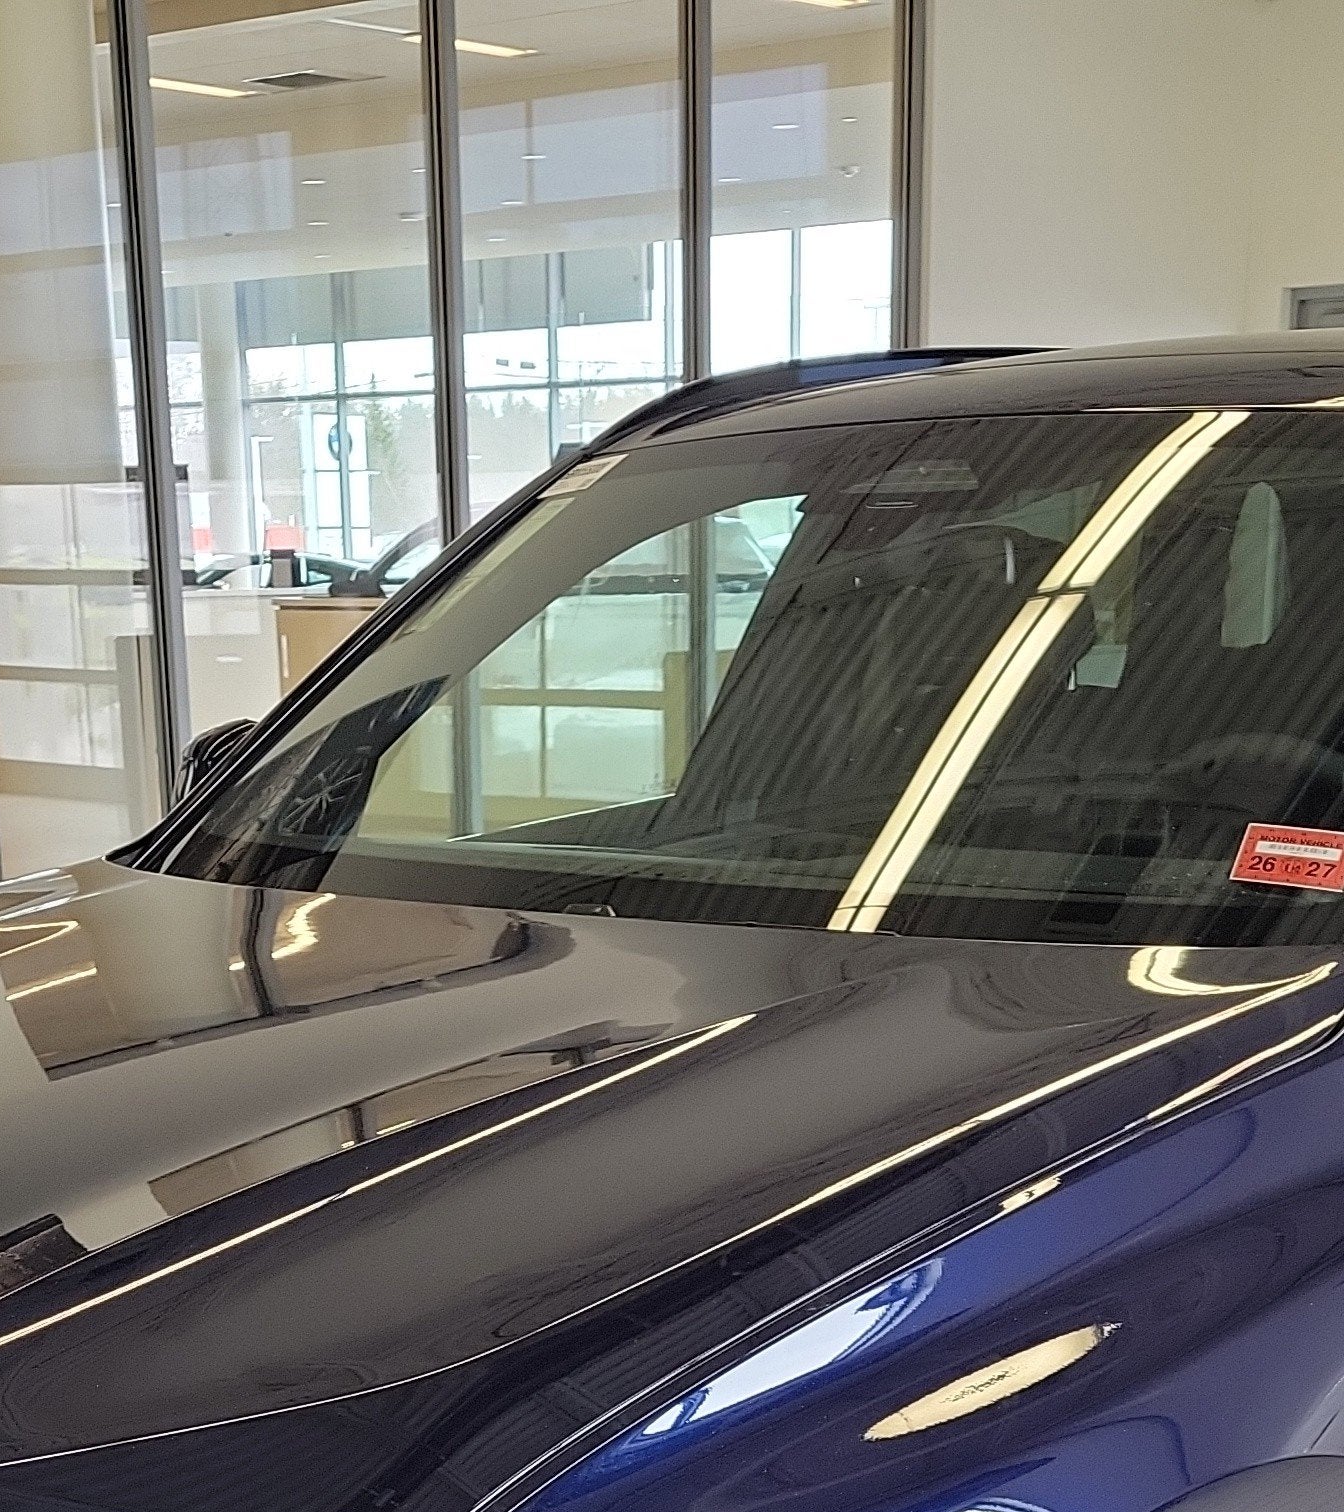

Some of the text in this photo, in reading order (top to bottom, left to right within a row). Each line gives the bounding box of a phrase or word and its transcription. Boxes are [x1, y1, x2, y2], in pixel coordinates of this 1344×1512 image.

[1260, 835, 1344, 849] MOTOR VEHICLE
[1247, 855, 1277, 872] 26
[1305, 862, 1338, 878] 27
